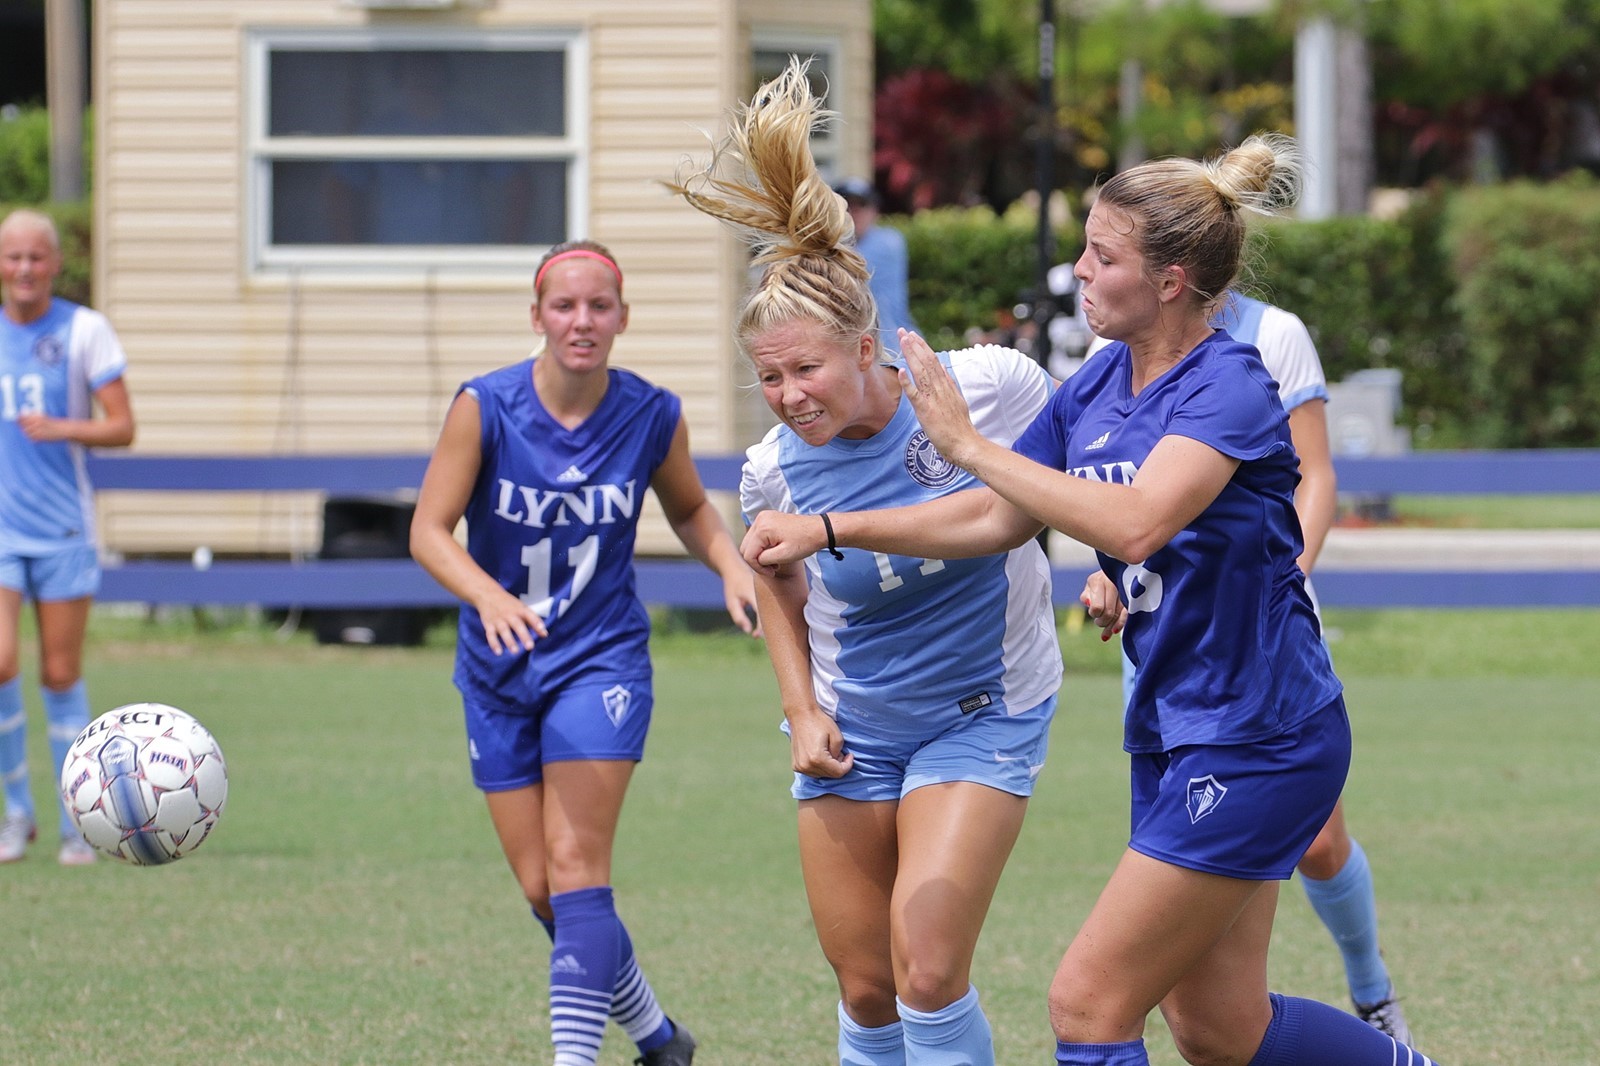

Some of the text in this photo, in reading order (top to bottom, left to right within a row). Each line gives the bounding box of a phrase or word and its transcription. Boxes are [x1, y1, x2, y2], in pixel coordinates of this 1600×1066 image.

[0, 374, 44, 420] 13
[907, 438, 920, 474] KEISER
[494, 478, 637, 529] LYNN
[519, 534, 600, 618] 11
[76, 711, 165, 748] SELECT
